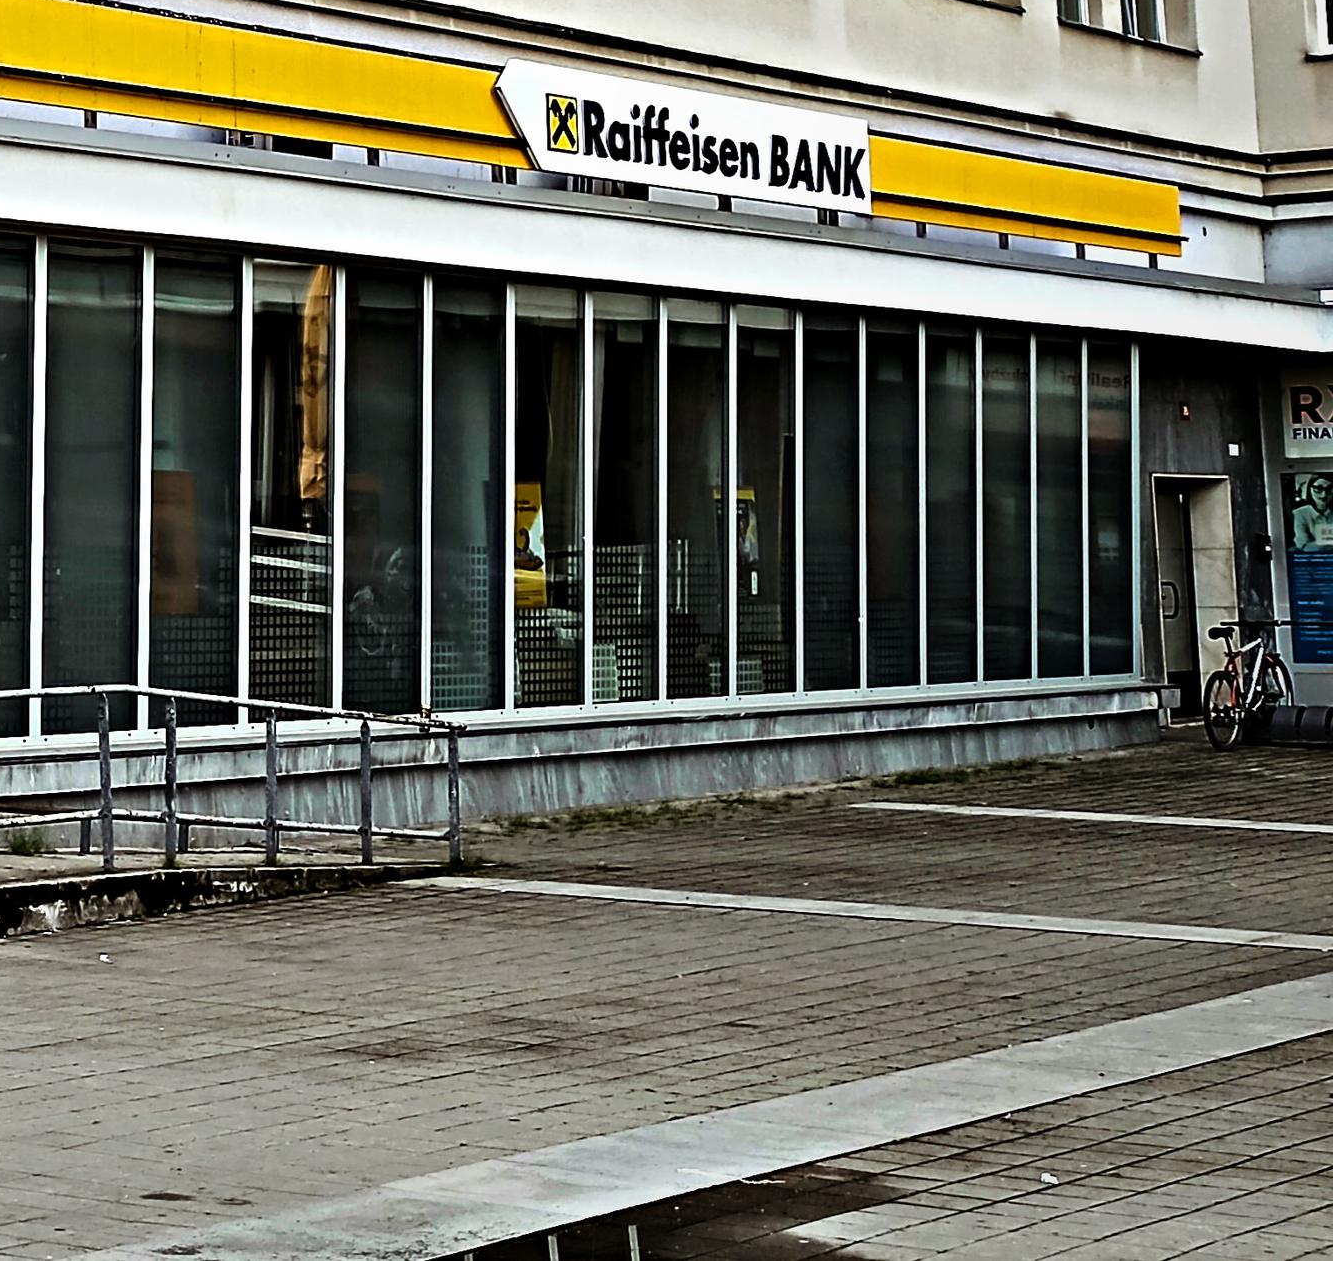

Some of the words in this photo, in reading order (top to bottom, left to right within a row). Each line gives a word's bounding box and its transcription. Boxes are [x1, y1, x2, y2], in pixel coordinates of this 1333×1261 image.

[582, 99, 761, 181] Raiffeisen
[769, 135, 865, 199] BANK
[1290, 385, 1333, 424] R
